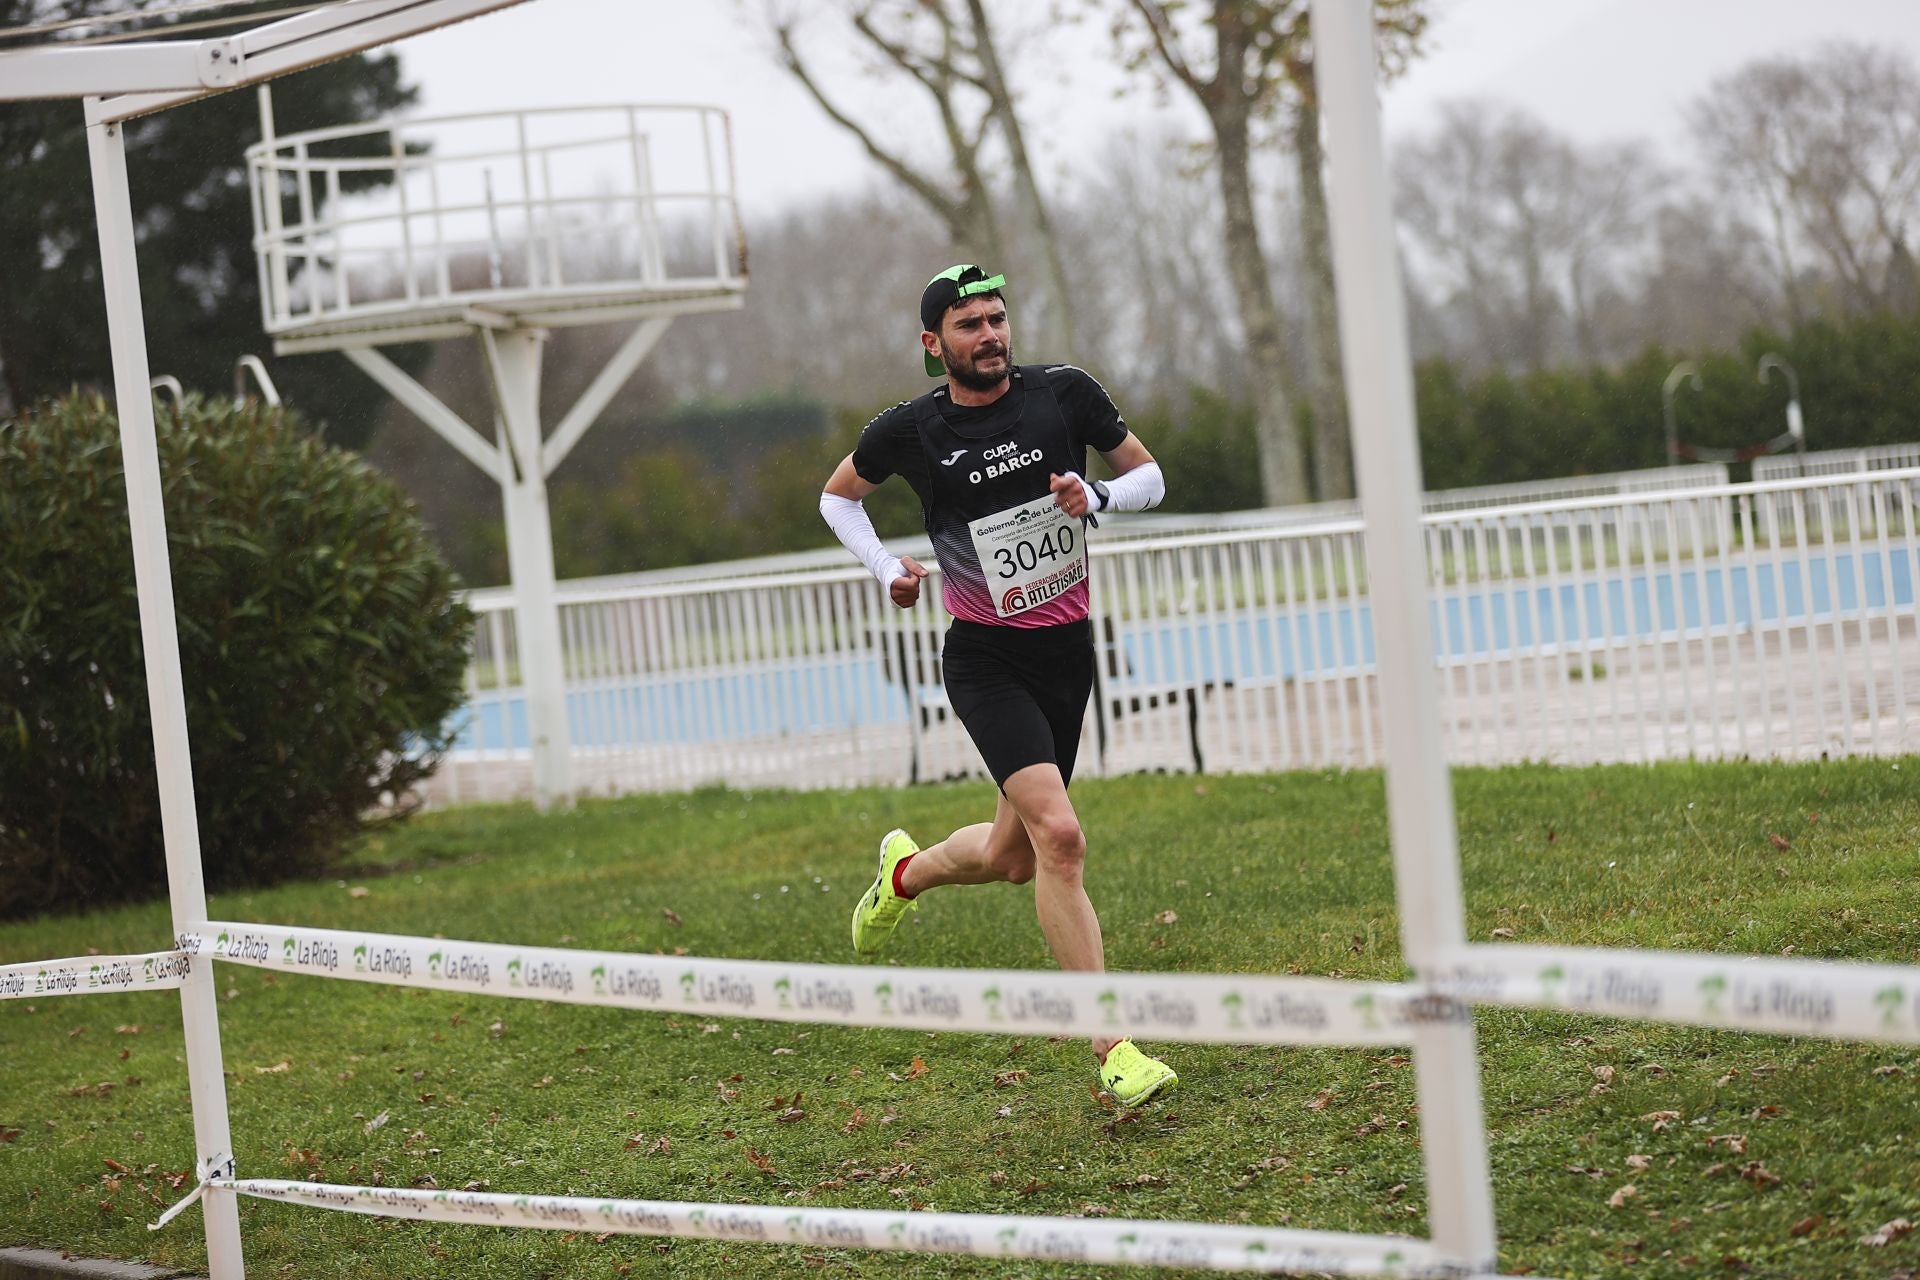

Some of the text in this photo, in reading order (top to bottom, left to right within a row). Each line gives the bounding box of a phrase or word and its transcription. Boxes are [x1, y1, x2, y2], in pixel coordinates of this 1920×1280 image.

[983, 441, 1018, 460] CUPA
[969, 471, 982, 484] O
[985, 449, 1043, 479] BARCO
[977, 519, 1016, 537] Gobierno
[1030, 510, 1041, 519] de
[1042, 506, 1053, 515] La
[994, 525, 1074, 579] 3040
[1025, 572, 1058, 591] FEDERACIÓN
[1028, 564, 1083, 605] ATLETISMO
[229, 934, 269, 963] La Rioja
[298, 940, 338, 971] La Rioja
[369, 948, 412, 978] La Rioja
[56, 968, 78, 992] Rioja
[110, 962, 133, 987] Rioja
[166, 953, 191, 980] Rioja
[445, 954, 490, 986] La Rioja
[525, 962, 574, 994] La Rioja
